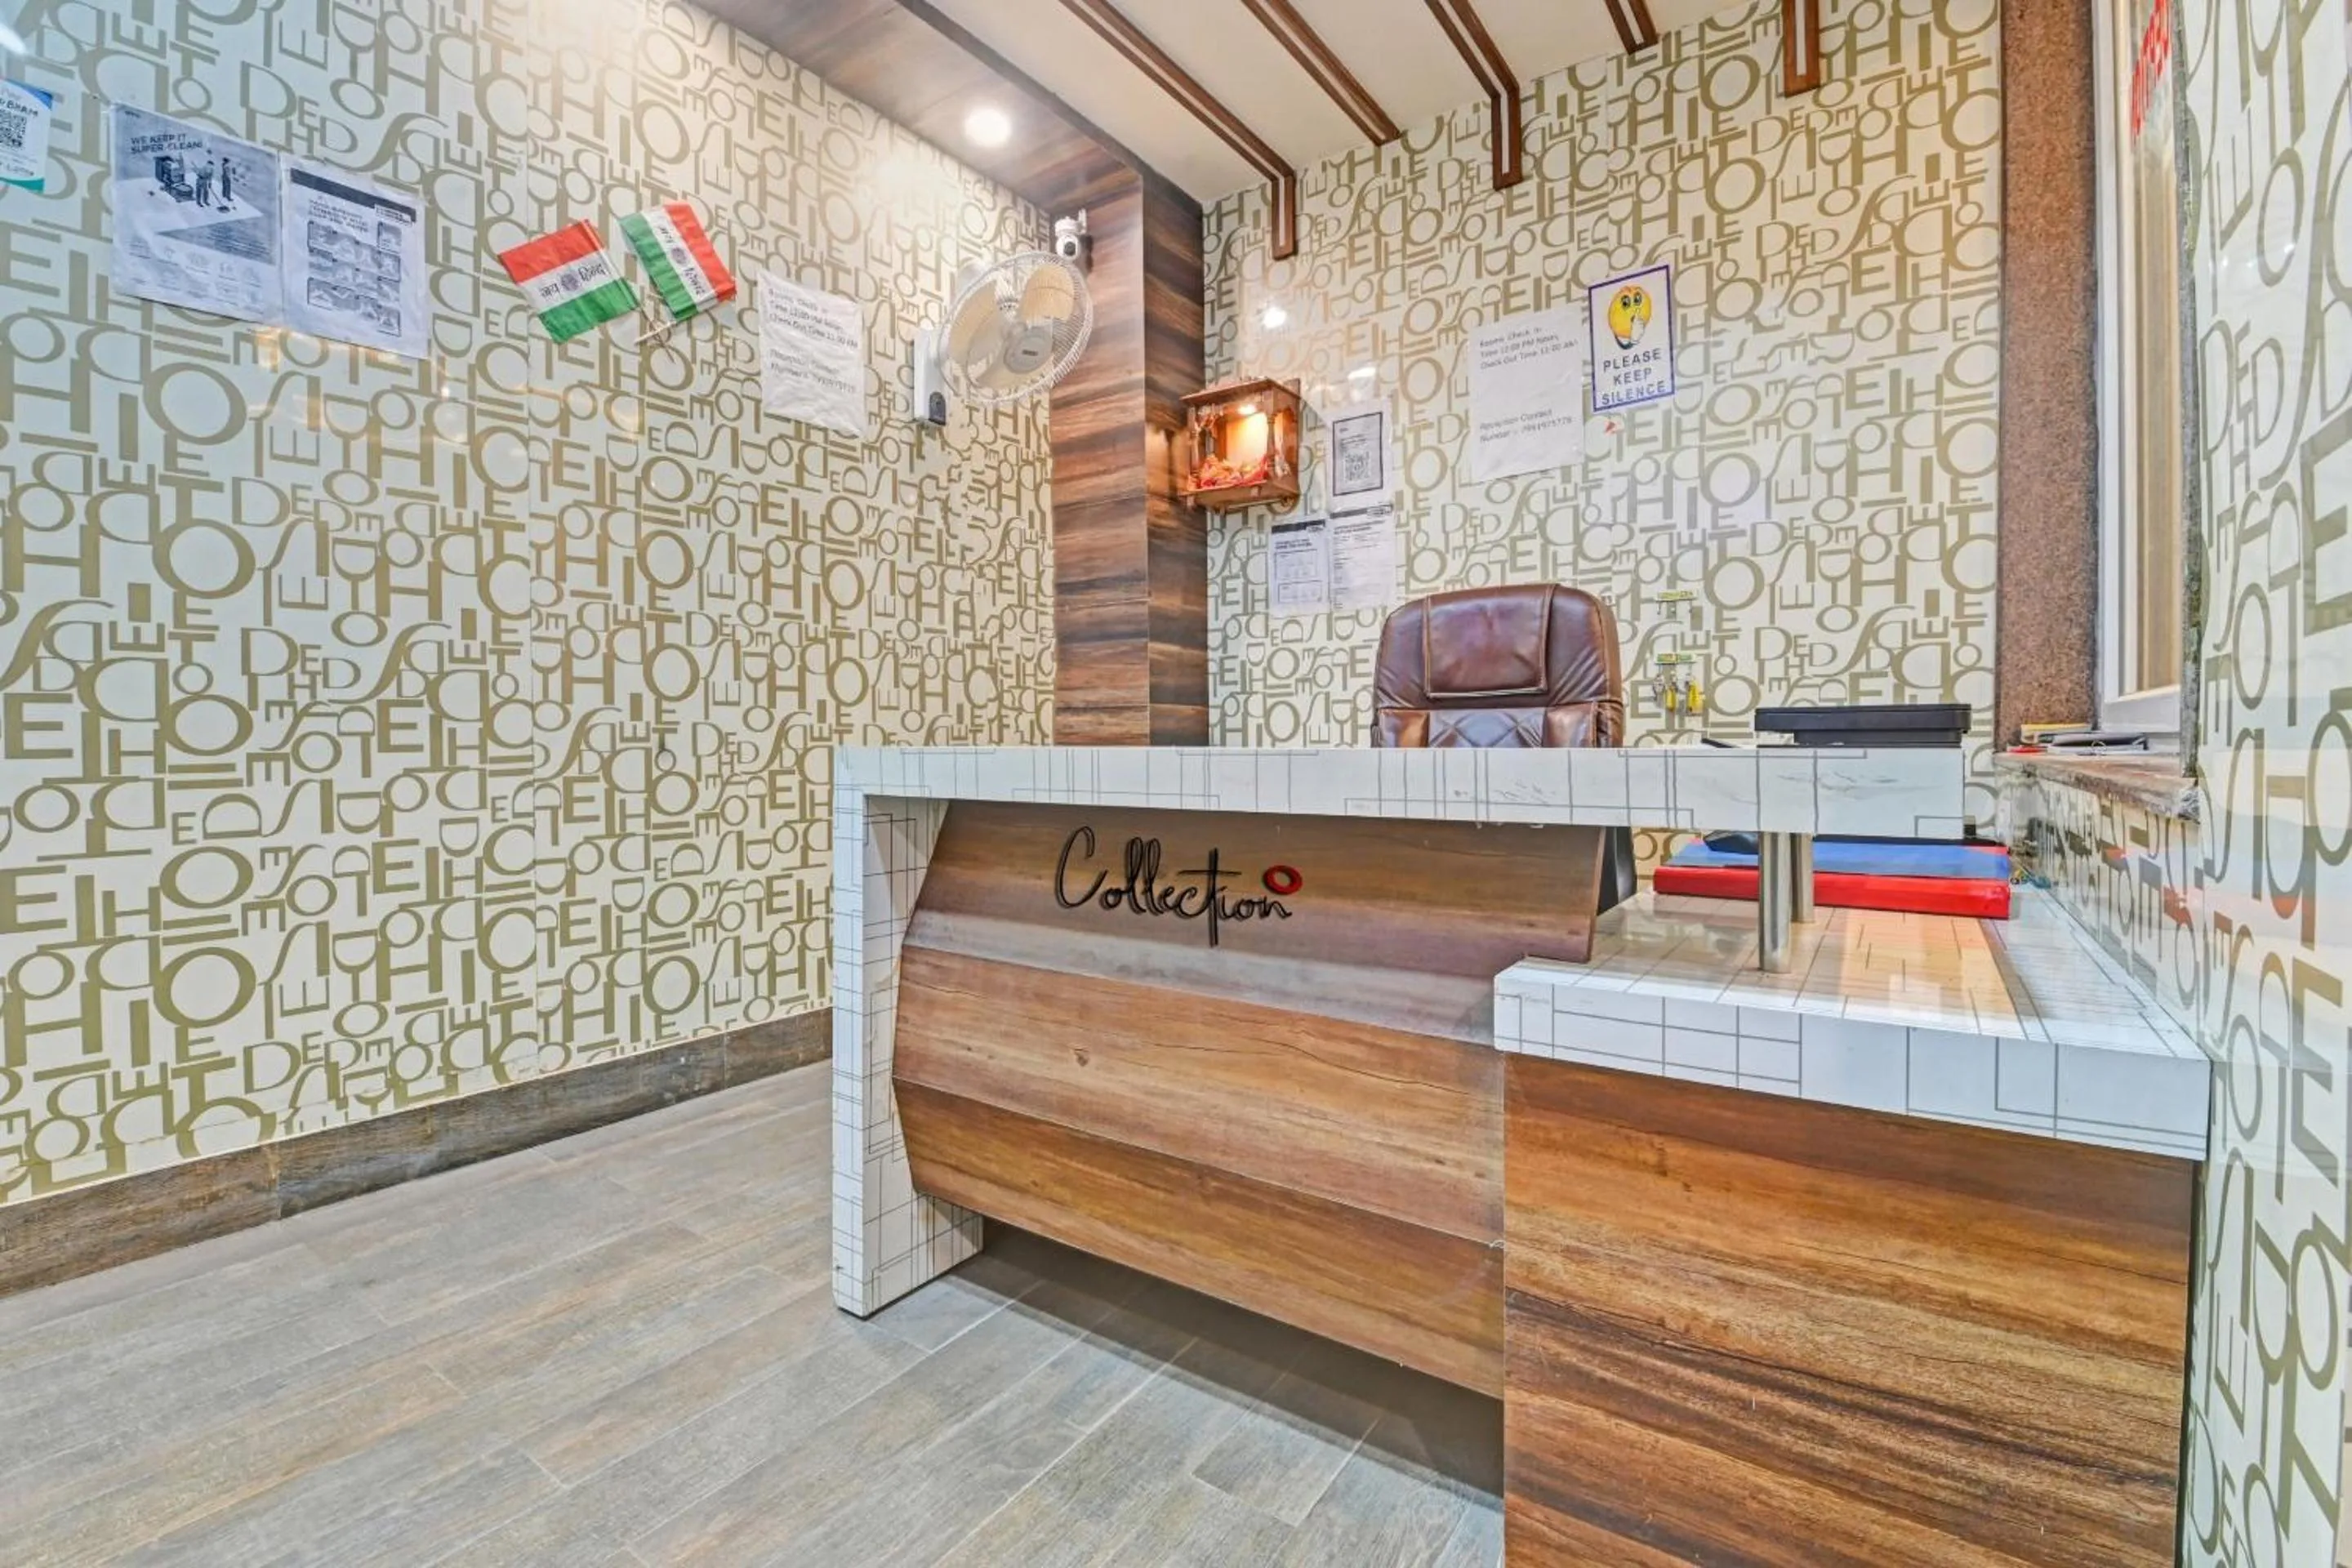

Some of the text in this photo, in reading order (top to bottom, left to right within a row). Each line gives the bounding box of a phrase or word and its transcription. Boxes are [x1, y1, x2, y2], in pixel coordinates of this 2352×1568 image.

[131, 132, 186, 145] WE KEEP IT
[131, 144, 164, 154] SUPER
[1602, 347, 1662, 373] PLEASE
[1613, 368, 1653, 387] KEEP
[1601, 380, 1666, 406] SILENCE
[1055, 826, 1292, 948] Collection
